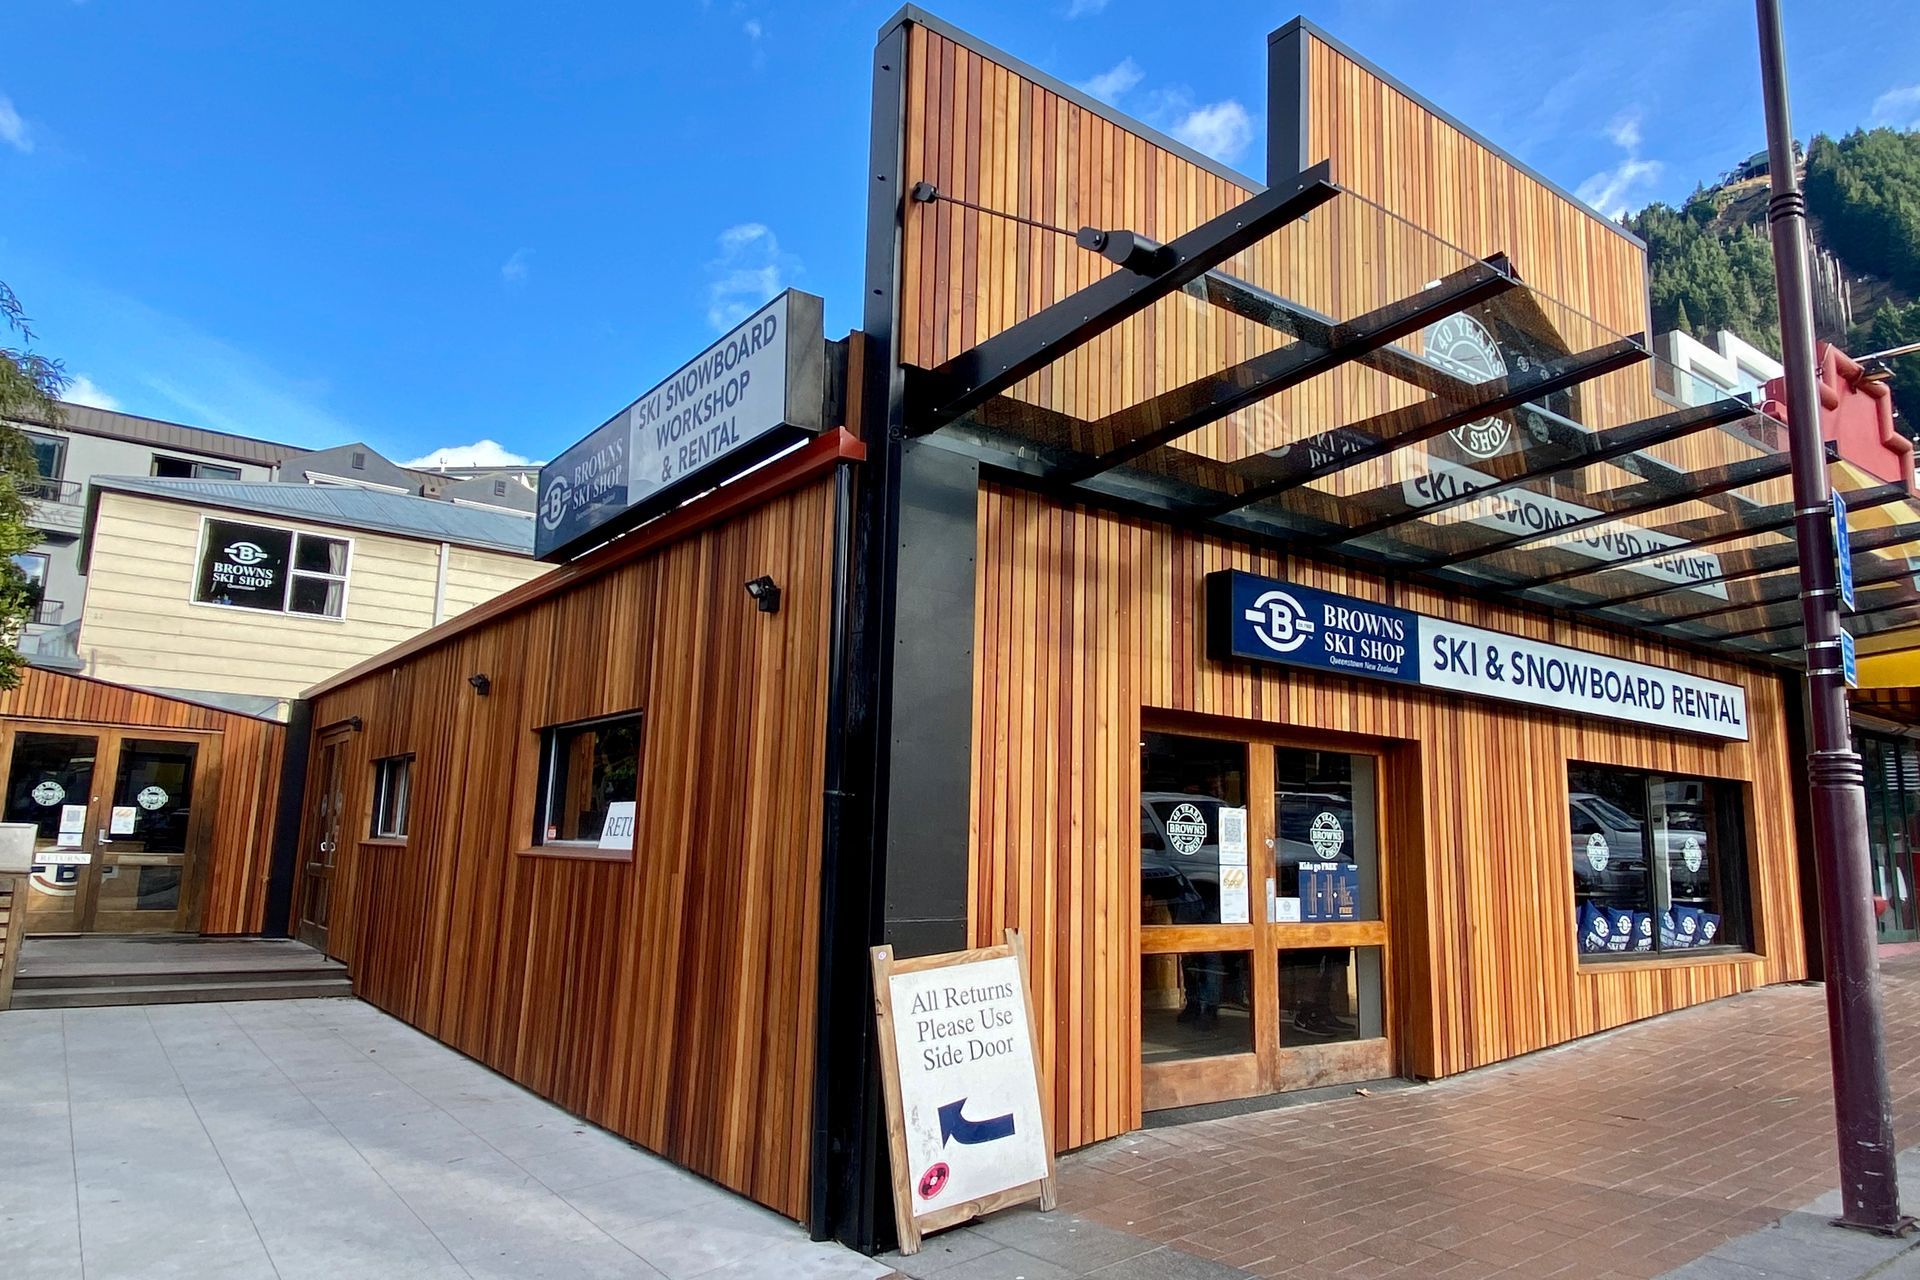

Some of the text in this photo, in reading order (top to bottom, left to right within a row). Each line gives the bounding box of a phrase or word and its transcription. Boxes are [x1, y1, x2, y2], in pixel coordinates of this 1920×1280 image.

[1437, 324, 1453, 350] 40
[1455, 317, 1505, 376] YEARS
[639, 314, 777, 430] SKI SNOWBOARD
[656, 370, 750, 451] WORKSHOP
[661, 415, 740, 482] & RENTAL
[1470, 418, 1506, 452] SHOP
[574, 437, 623, 489] BROWNS
[572, 484, 591, 510] SKI
[593, 464, 622, 498] SHOP
[212, 572, 235, 584] SKI
[238, 576, 273, 588] SHOP
[213, 562, 274, 579] BROWNS
[1323, 603, 1405, 641] BROWNS
[1324, 631, 1405, 664] SKI SHOP
[1433, 634, 1741, 726] SKI & SNOWBOARD RENTAL
[1169, 823, 1205, 835] BROWNS
[1312, 830, 1342, 840] BROWNS
[40, 854, 87, 863] RETURNS
[910, 981, 1013, 1015] All Returns
[916, 1007, 1013, 1043] Please Use
[923, 1037, 1014, 1072] Side Door
